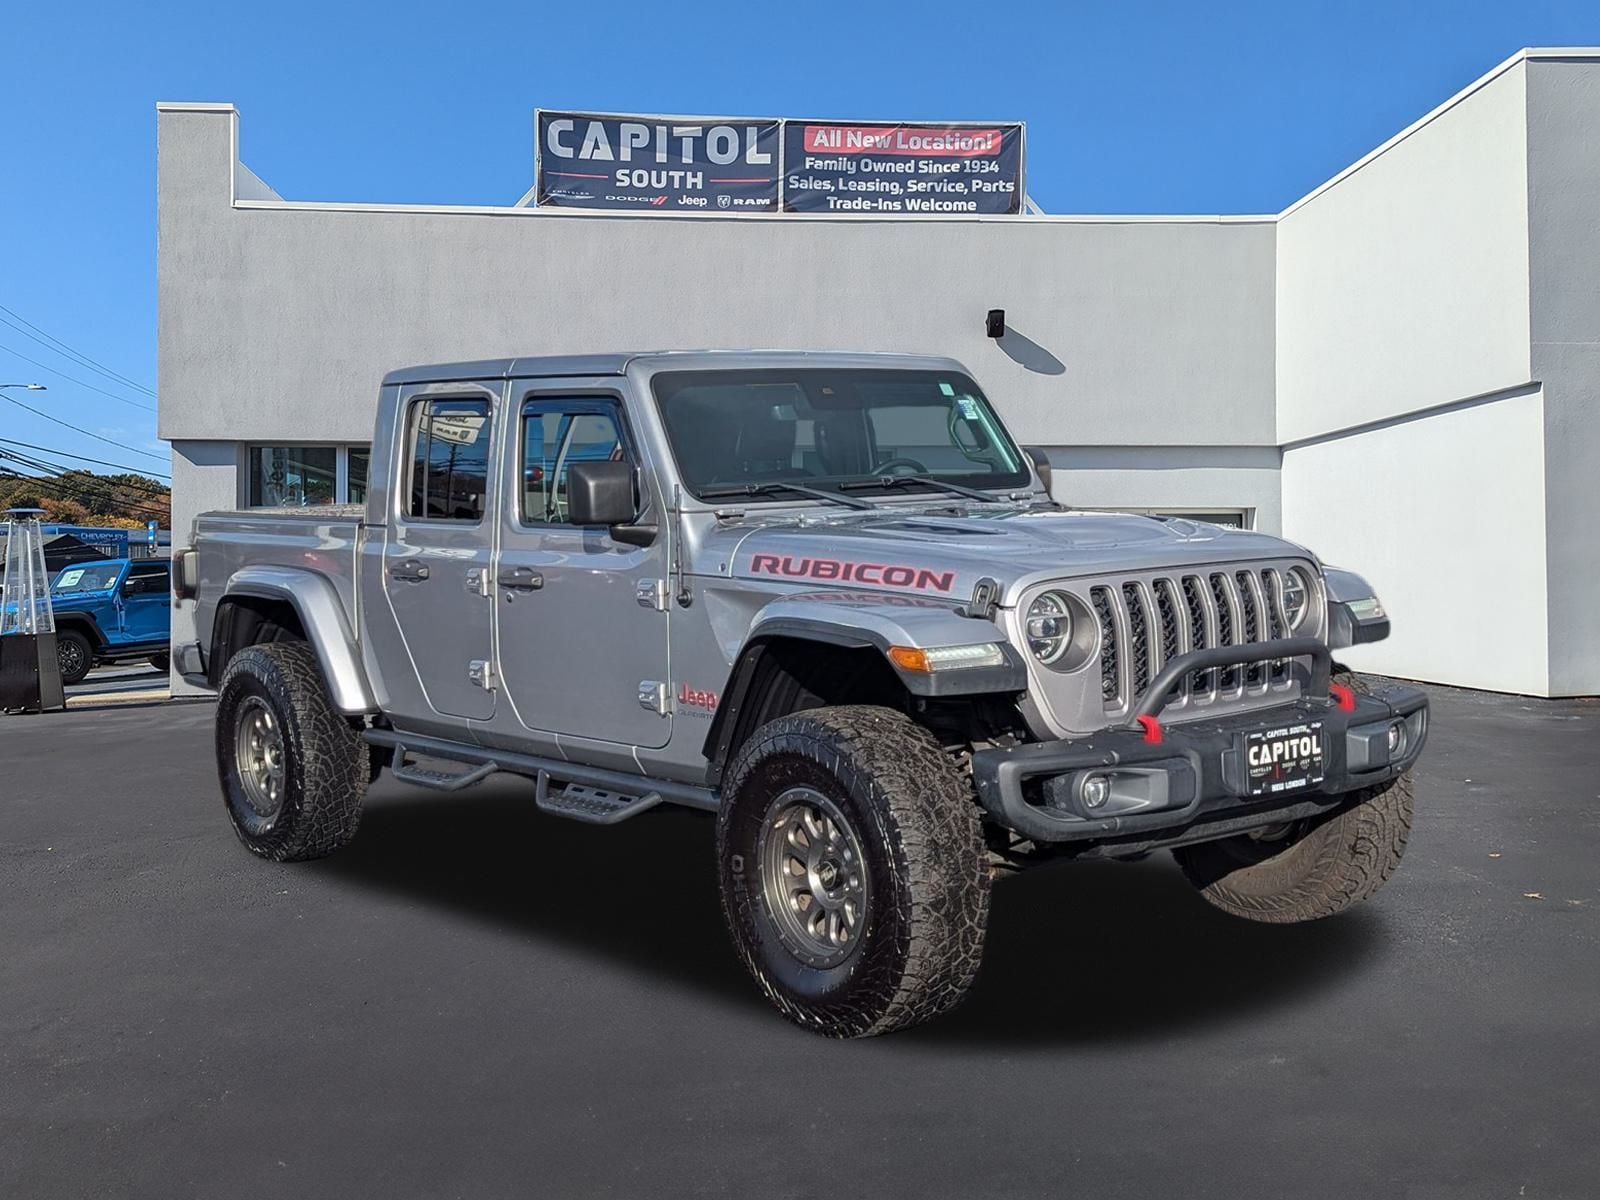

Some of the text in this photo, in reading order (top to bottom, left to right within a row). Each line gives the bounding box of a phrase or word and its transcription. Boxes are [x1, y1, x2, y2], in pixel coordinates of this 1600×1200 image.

[547, 119, 772, 165] CAPITOL
[813, 129, 993, 150] All New Location!
[805, 157, 1000, 174] Family Owned Since 1934
[615, 168, 703, 190] SOUTH
[788, 176, 1015, 195] Sales, Leasing, Service, Parts
[678, 195, 708, 207] Jeep
[733, 198, 771, 206] RAM
[826, 196, 977, 212] Trade-Ins Welcome
[751, 554, 954, 592] RUBICON
[677, 682, 717, 711] Jeep
[678, 709, 715, 720] GLADIATO
[1266, 728, 1289, 739] CAPITOL
[1249, 735, 1321, 766] CAPITOL
